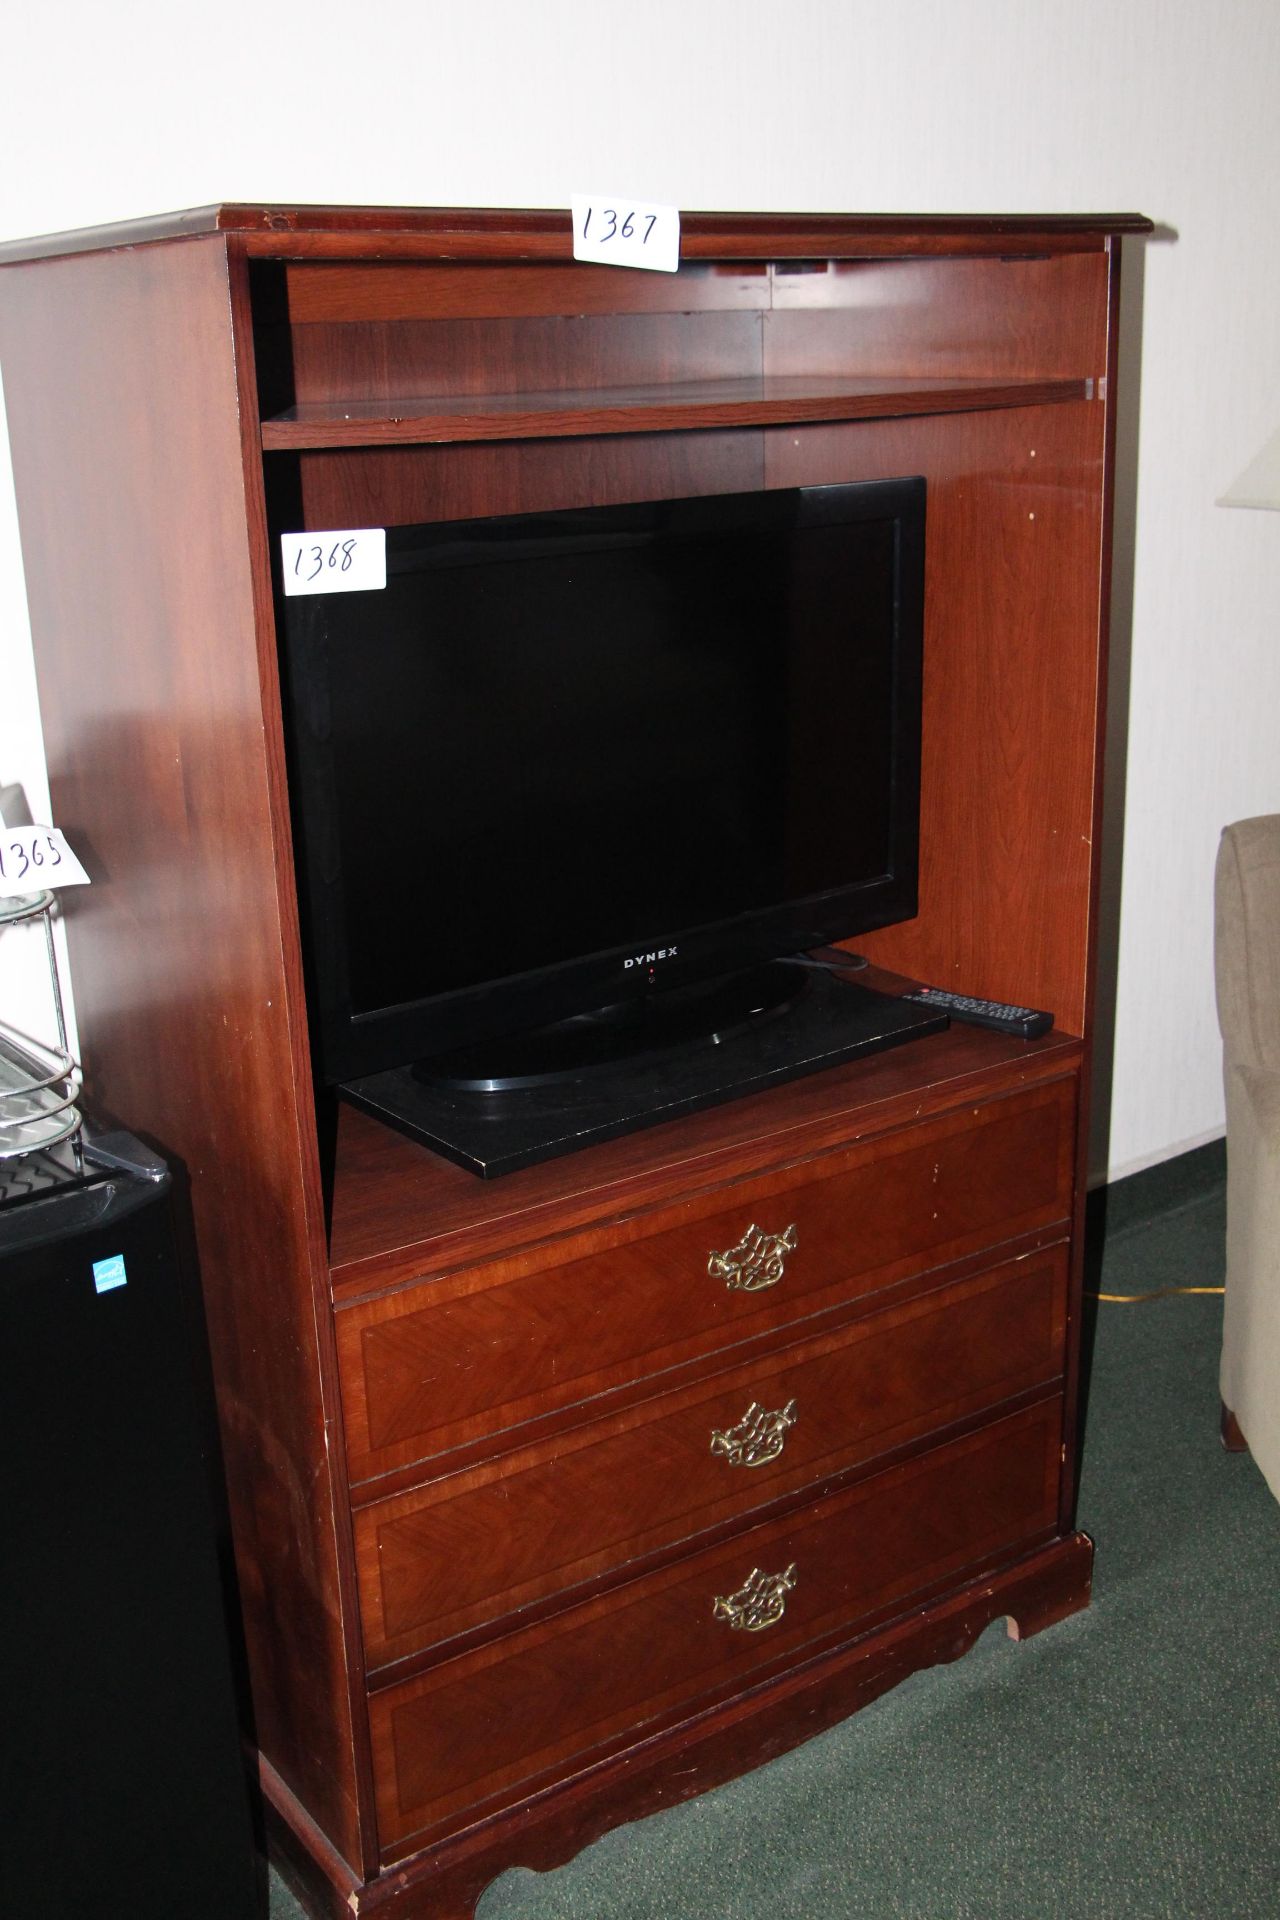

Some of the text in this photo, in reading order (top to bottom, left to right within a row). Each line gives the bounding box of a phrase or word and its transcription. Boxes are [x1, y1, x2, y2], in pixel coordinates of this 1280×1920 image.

[583, 207, 657, 244] 1367
[294, 538, 358, 582] 1368
[623, 946, 678, 969] DYNEX
